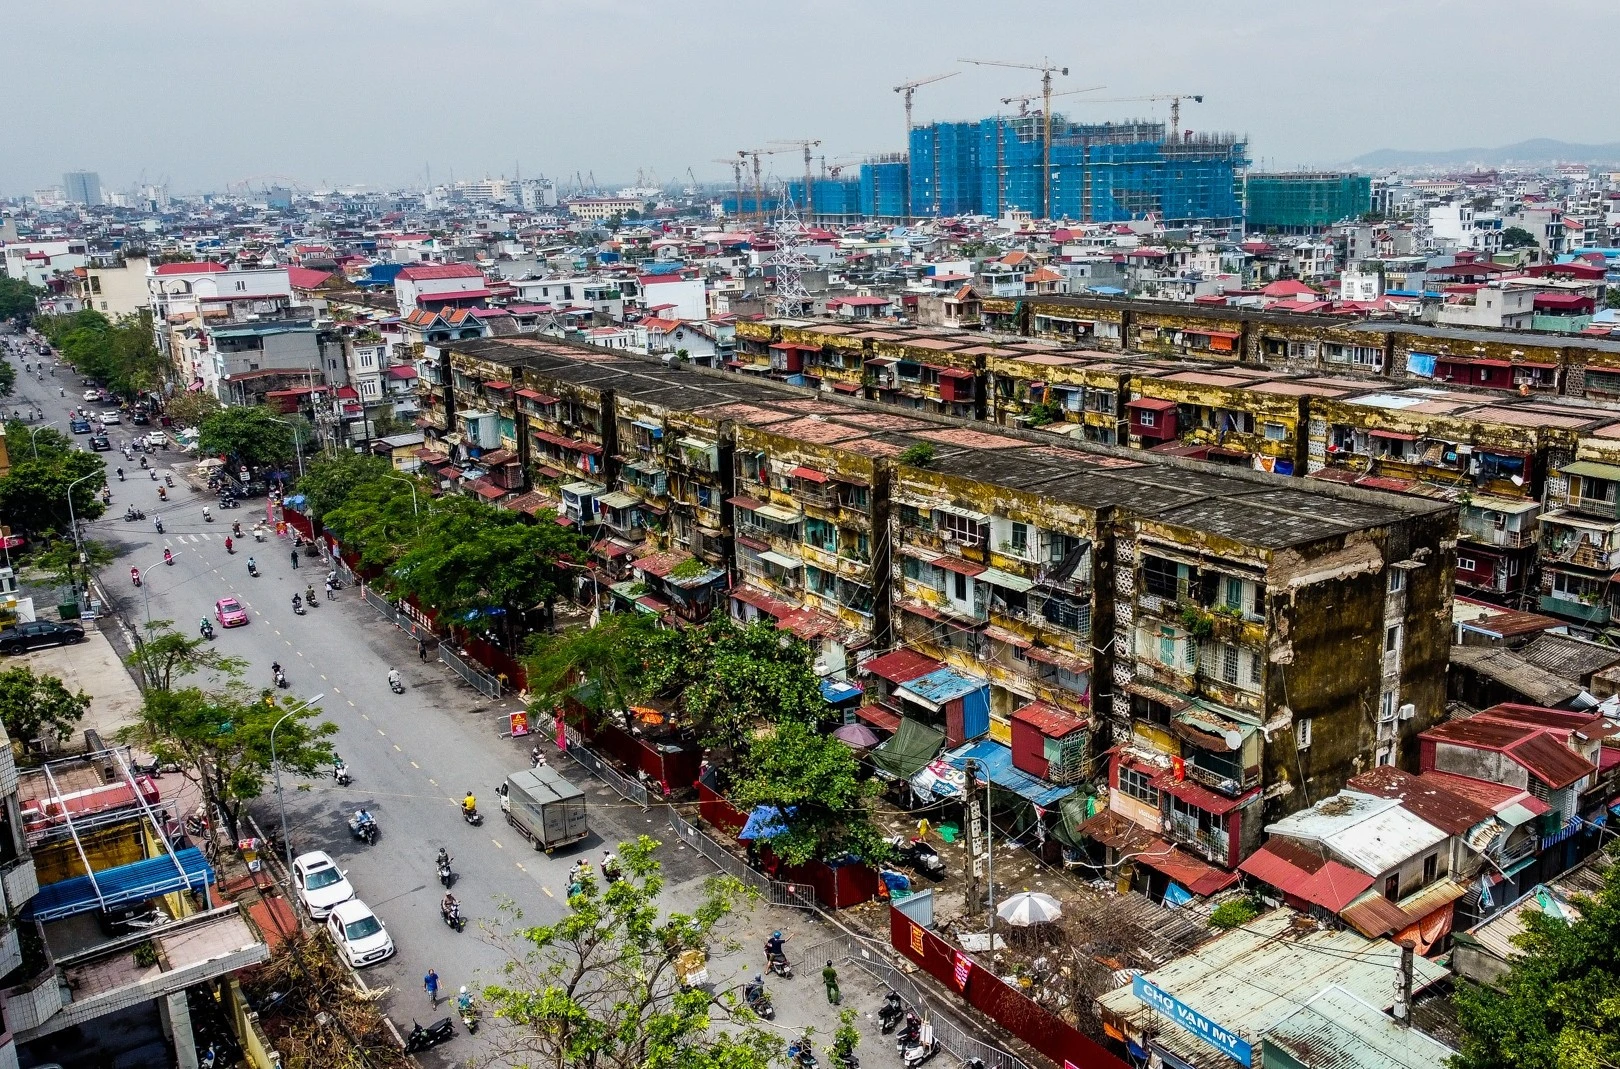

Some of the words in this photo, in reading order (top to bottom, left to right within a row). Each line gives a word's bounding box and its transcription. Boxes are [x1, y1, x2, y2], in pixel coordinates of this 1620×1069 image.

[1143, 984, 1174, 1010] CHỢ
[1177, 1005, 1209, 1033] VẠN
[1212, 1027, 1237, 1049] MỸ
